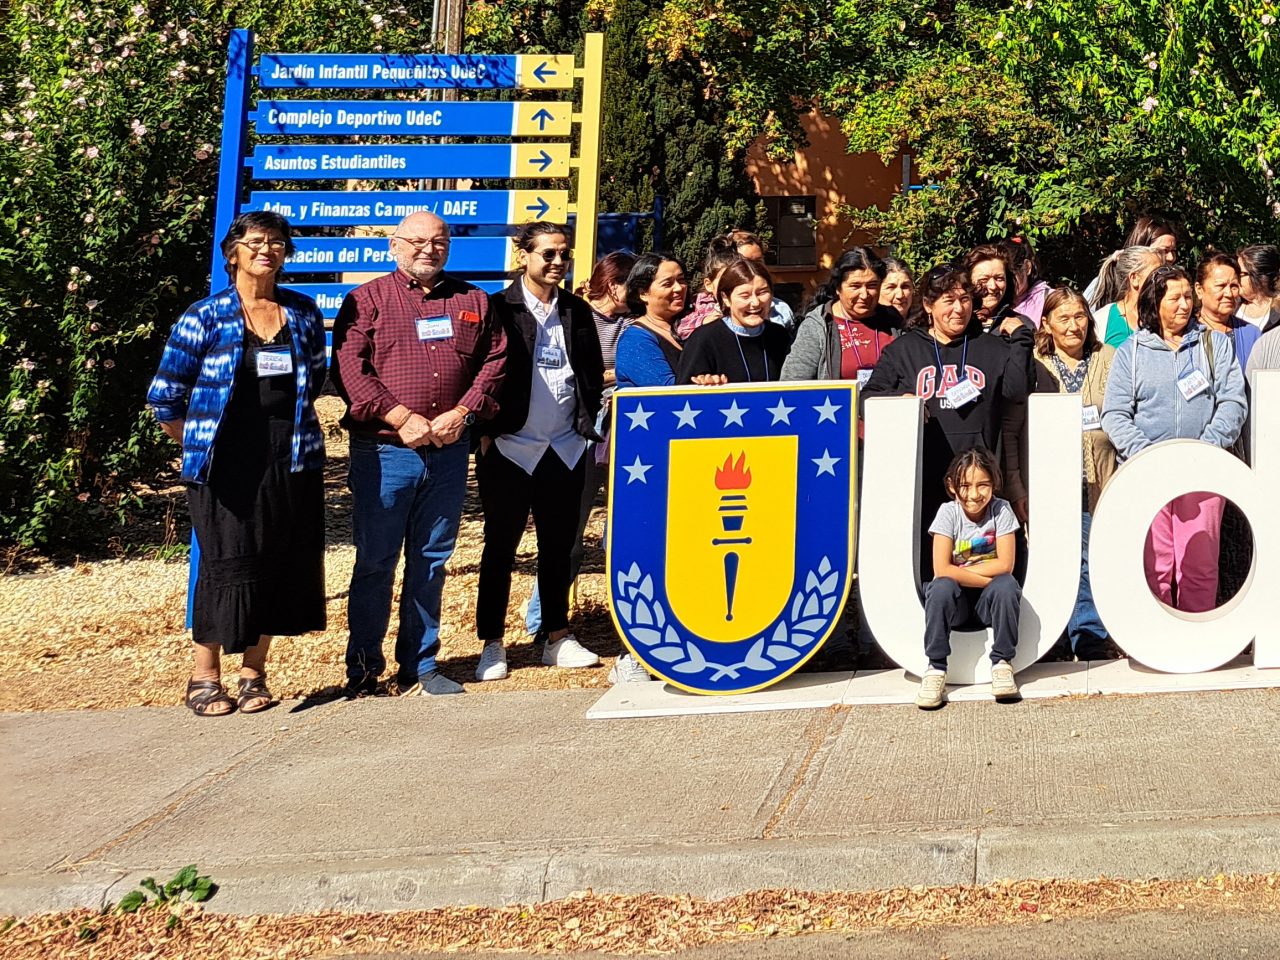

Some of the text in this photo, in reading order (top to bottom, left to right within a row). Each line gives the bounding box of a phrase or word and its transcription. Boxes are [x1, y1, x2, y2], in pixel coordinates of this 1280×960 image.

[271, 63, 486, 82] Jardín Infantil Pequeñitos UdeC
[268, 108, 442, 128] Complejo Deportivo UdeC
[264, 155, 406, 170] Asuntos Estudiantiles
[263, 201, 296, 217] Adm.
[300, 205, 308, 220] y
[311, 201, 370, 217] Finanzas
[374, 201, 430, 217] Campus
[443, 200, 478, 216] DAFE
[338, 247, 359, 262] del
[916, 364, 986, 401] GAP
